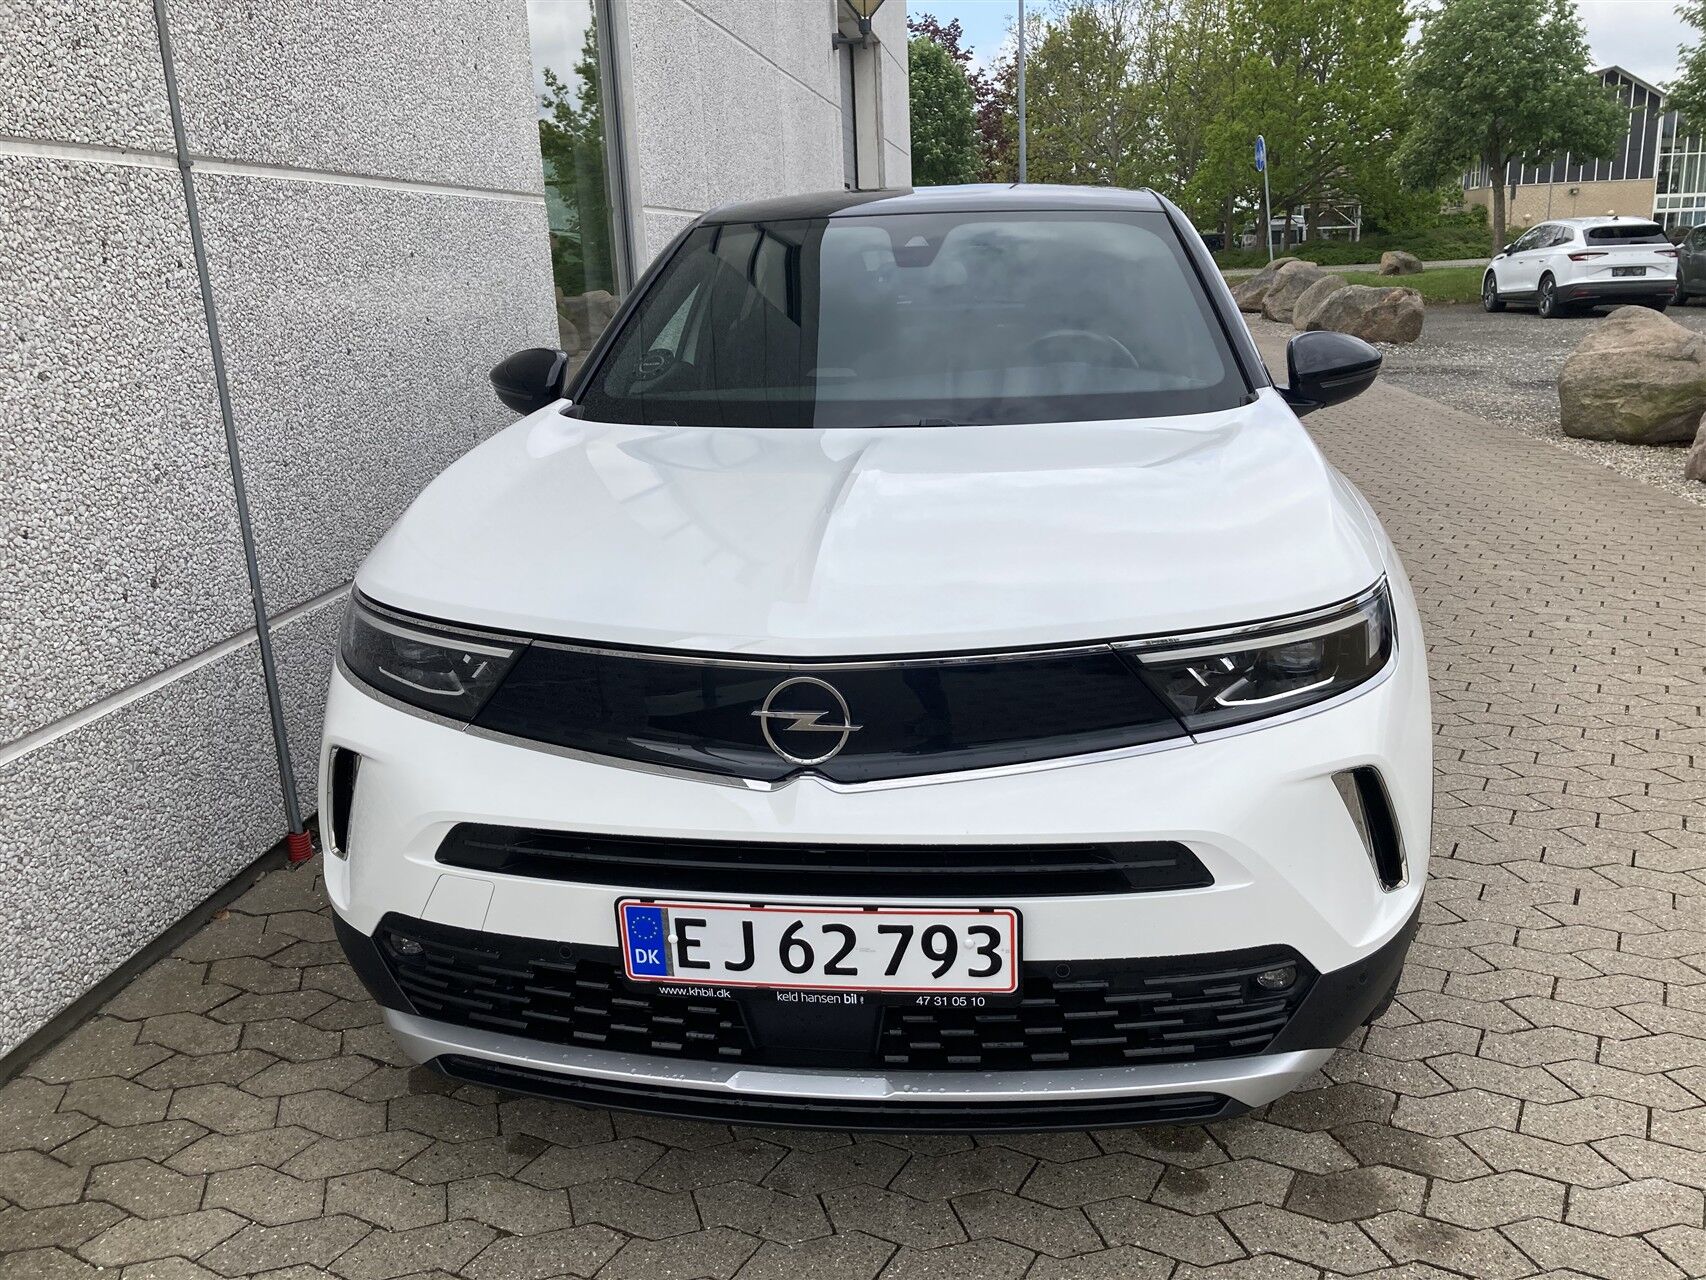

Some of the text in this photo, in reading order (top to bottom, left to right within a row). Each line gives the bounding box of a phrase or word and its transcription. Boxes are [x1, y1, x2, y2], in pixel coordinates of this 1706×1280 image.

[675, 918, 1003, 980] EJ 62 793
[635, 948, 661, 965] DK
[658, 986, 731, 999] www.khbil.dk
[776, 991, 799, 1003] keld
[800, 992, 841, 1005] hansen
[843, 993, 857, 1004] bil
[915, 996, 986, 1007] 47 31 05 10
